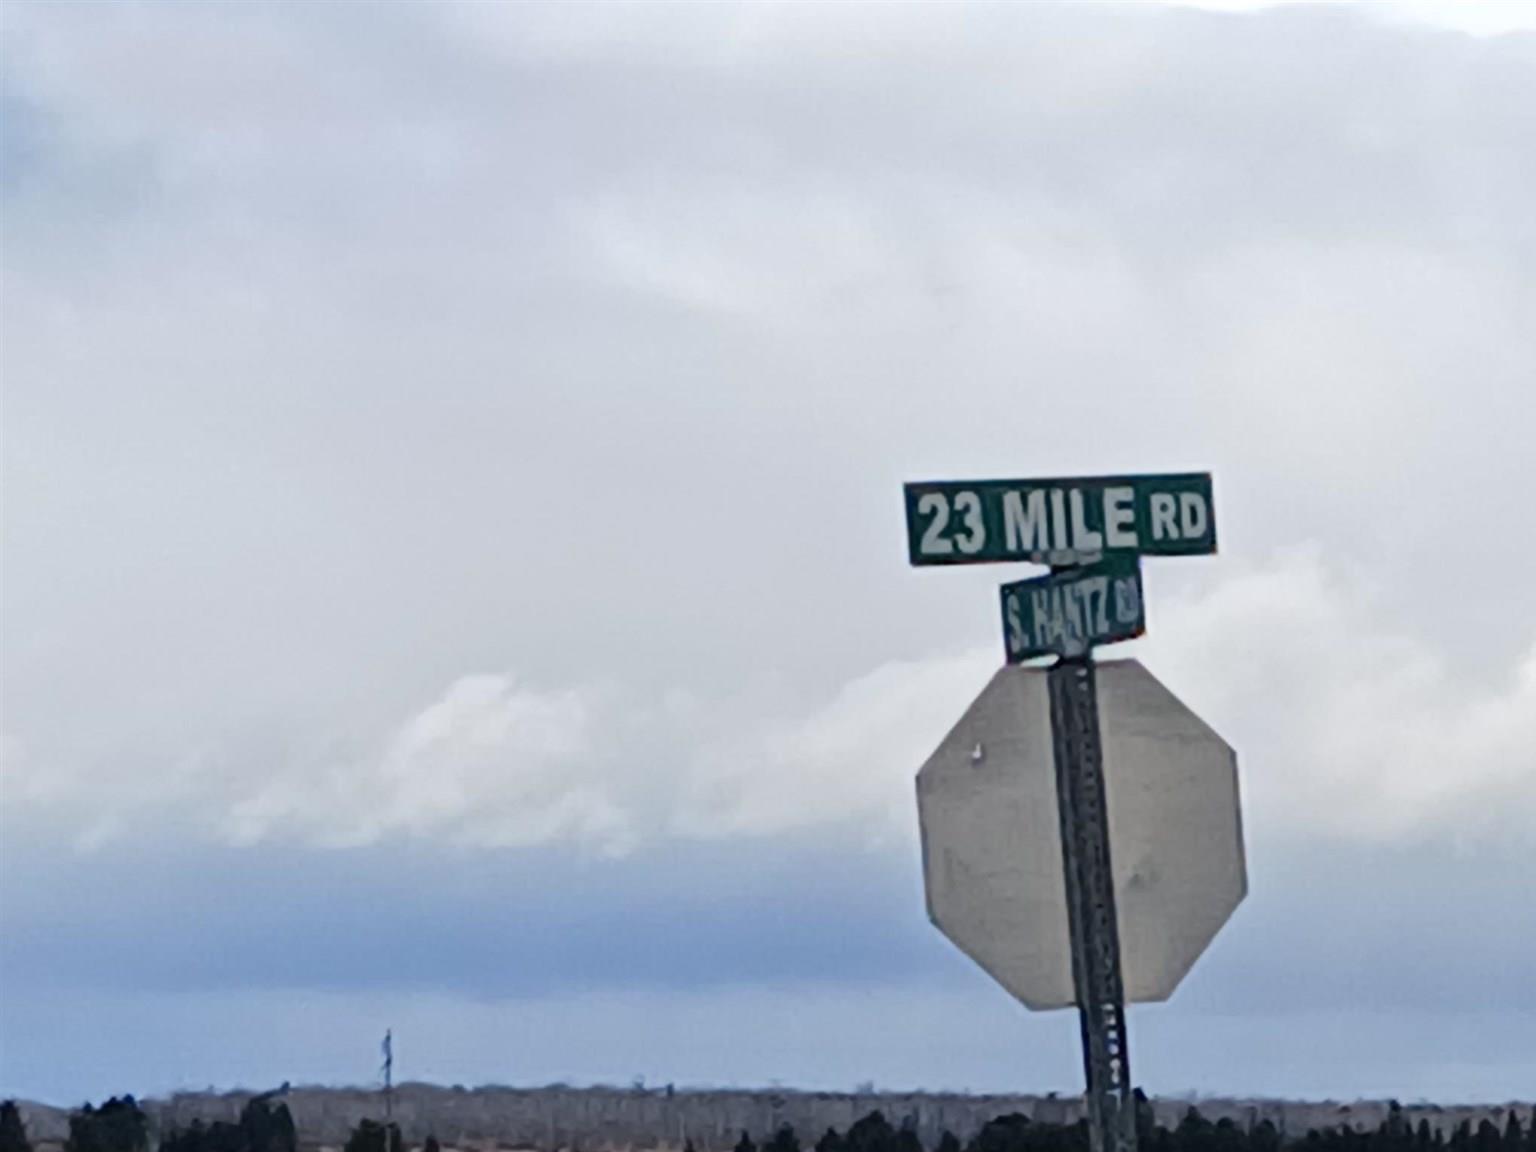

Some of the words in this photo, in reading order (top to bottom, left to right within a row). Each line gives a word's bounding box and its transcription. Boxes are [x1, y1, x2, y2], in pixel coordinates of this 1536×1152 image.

[917, 490, 986, 555] 23
[1002, 486, 1139, 551] MILE
[1150, 491, 1208, 541] RD
[1031, 576, 1110, 648] HANTZ
